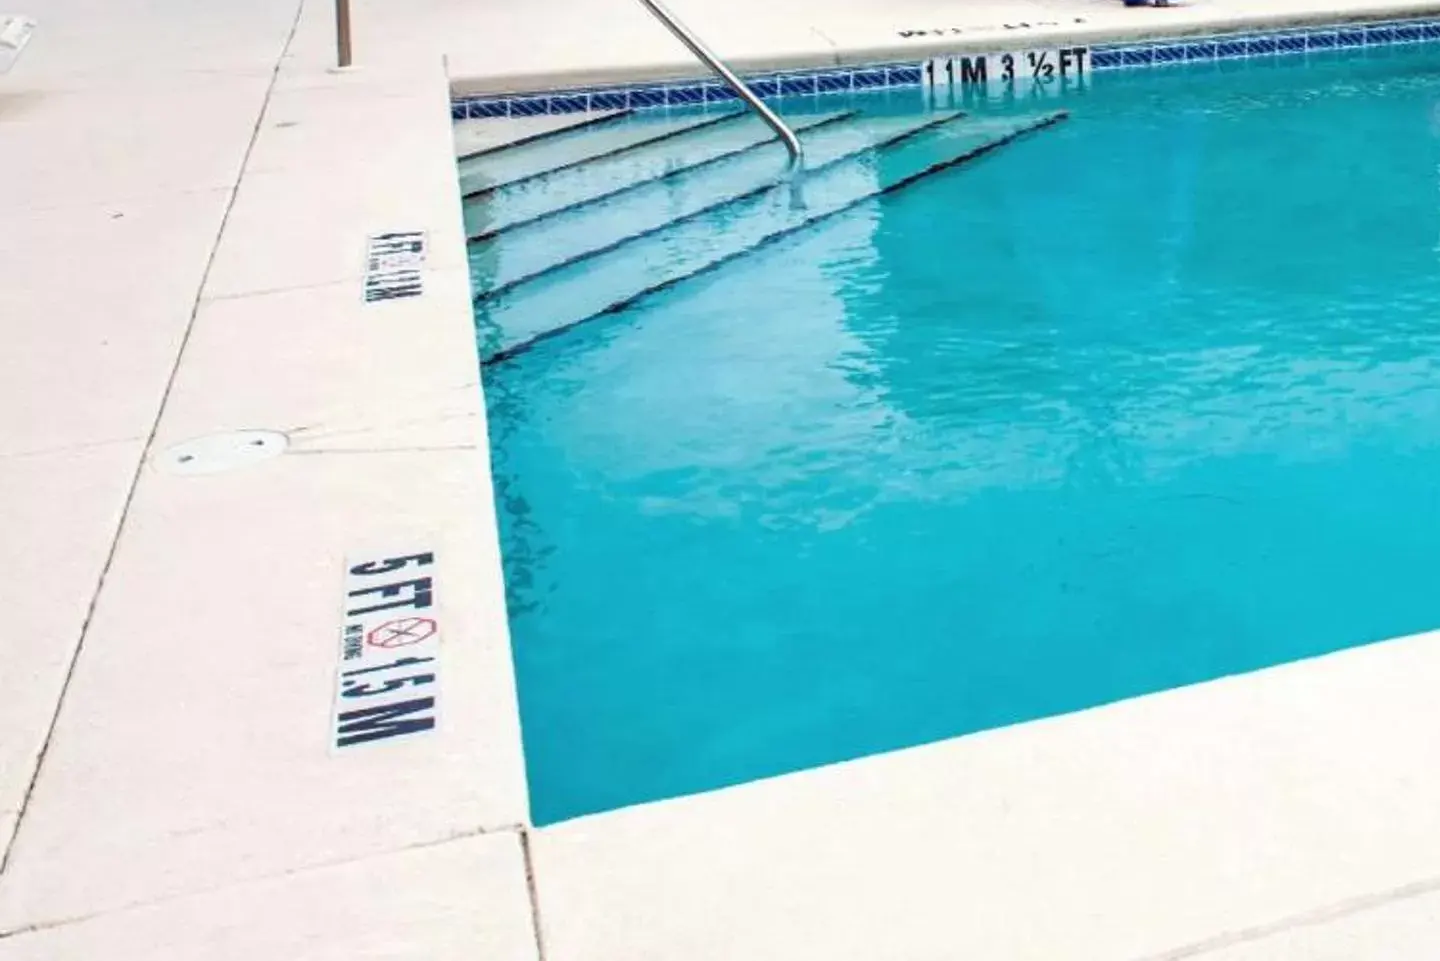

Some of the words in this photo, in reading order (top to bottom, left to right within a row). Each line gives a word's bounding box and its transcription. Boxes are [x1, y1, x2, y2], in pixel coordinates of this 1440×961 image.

[1002, 53, 1014, 81] 3
[1059, 47, 1087, 78] FT
[349, 551, 434, 576] 5
[347, 576, 433, 617] FT
